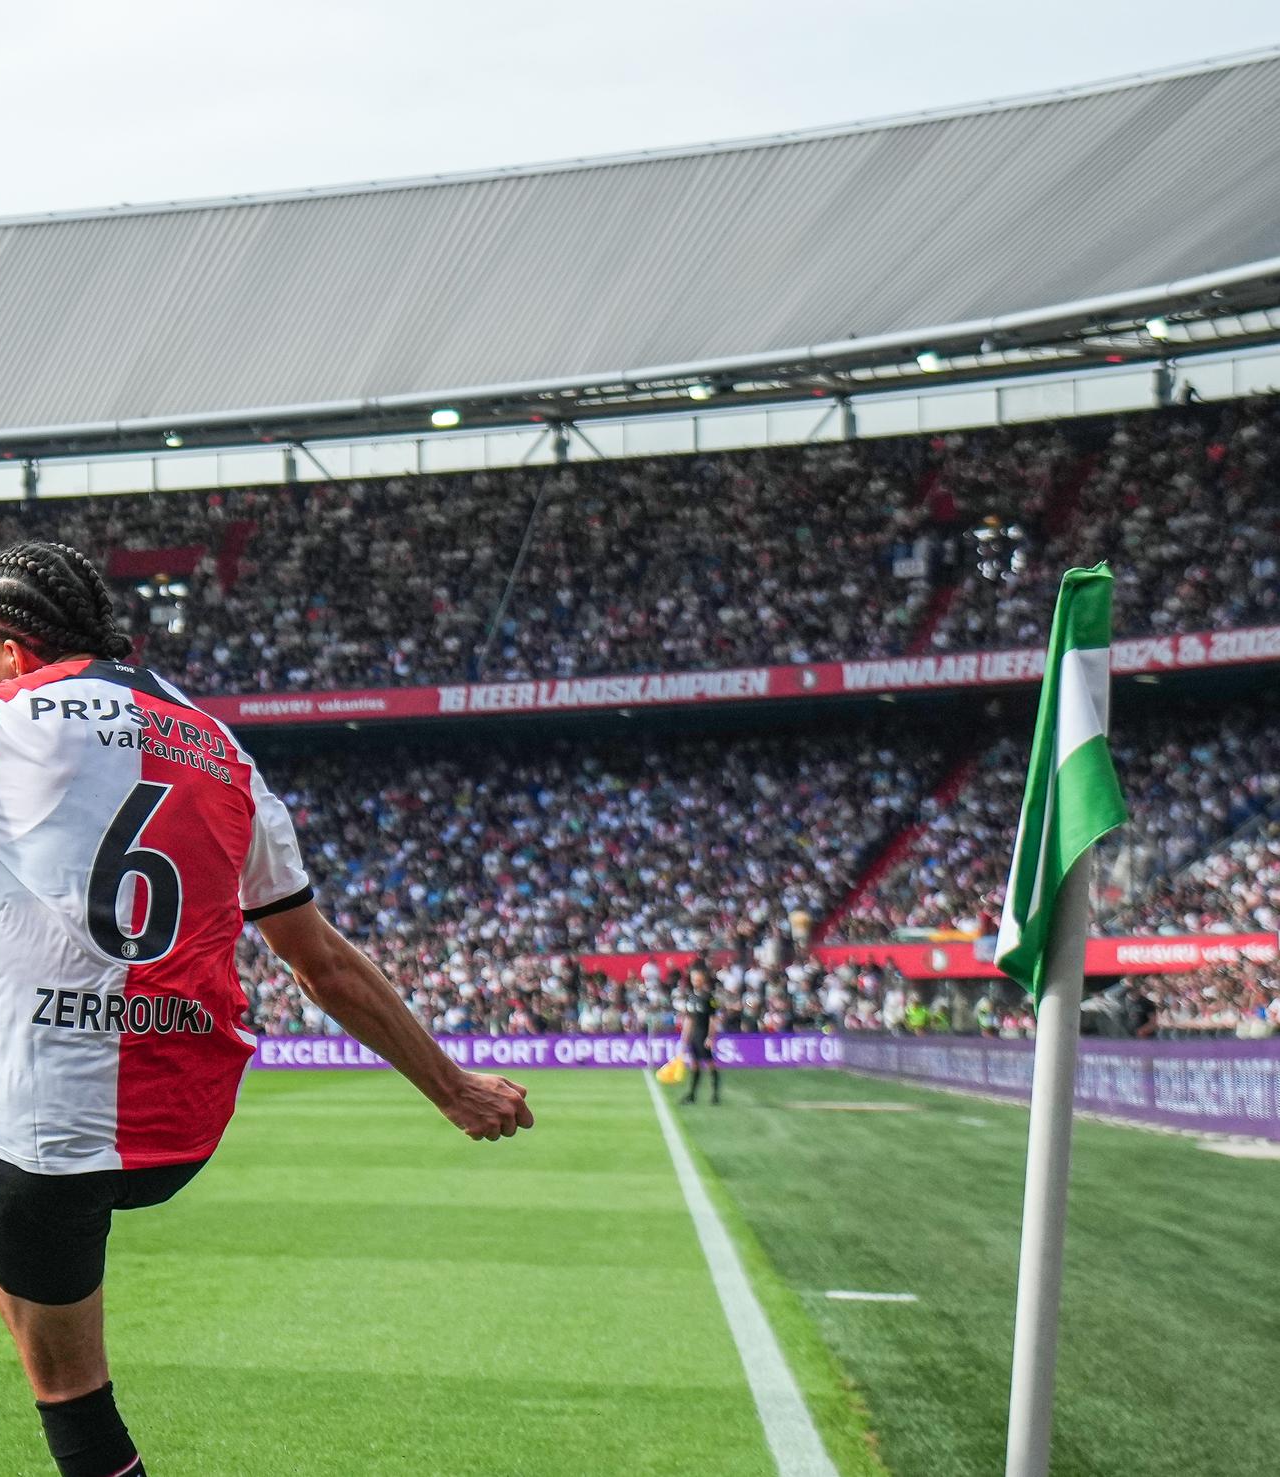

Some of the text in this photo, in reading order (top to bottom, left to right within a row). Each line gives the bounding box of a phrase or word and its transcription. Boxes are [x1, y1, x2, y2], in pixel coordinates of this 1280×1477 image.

[115, 664, 135, 674] 1908
[843, 654, 979, 690] WINNAAR
[1110, 638, 1173, 672] 1974
[317, 697, 386, 713] vakanties
[438, 669, 768, 712] 16 KEER LANDSKAMPIOEN
[97, 727, 232, 786] vakanties
[86, 780, 183, 966] 6
[260, 1040, 387, 1065] EXCELLE
[473, 1039, 548, 1064] PORT
[554, 1037, 744, 1064] OPERATIS.
[764, 1037, 818, 1062] LIFT
